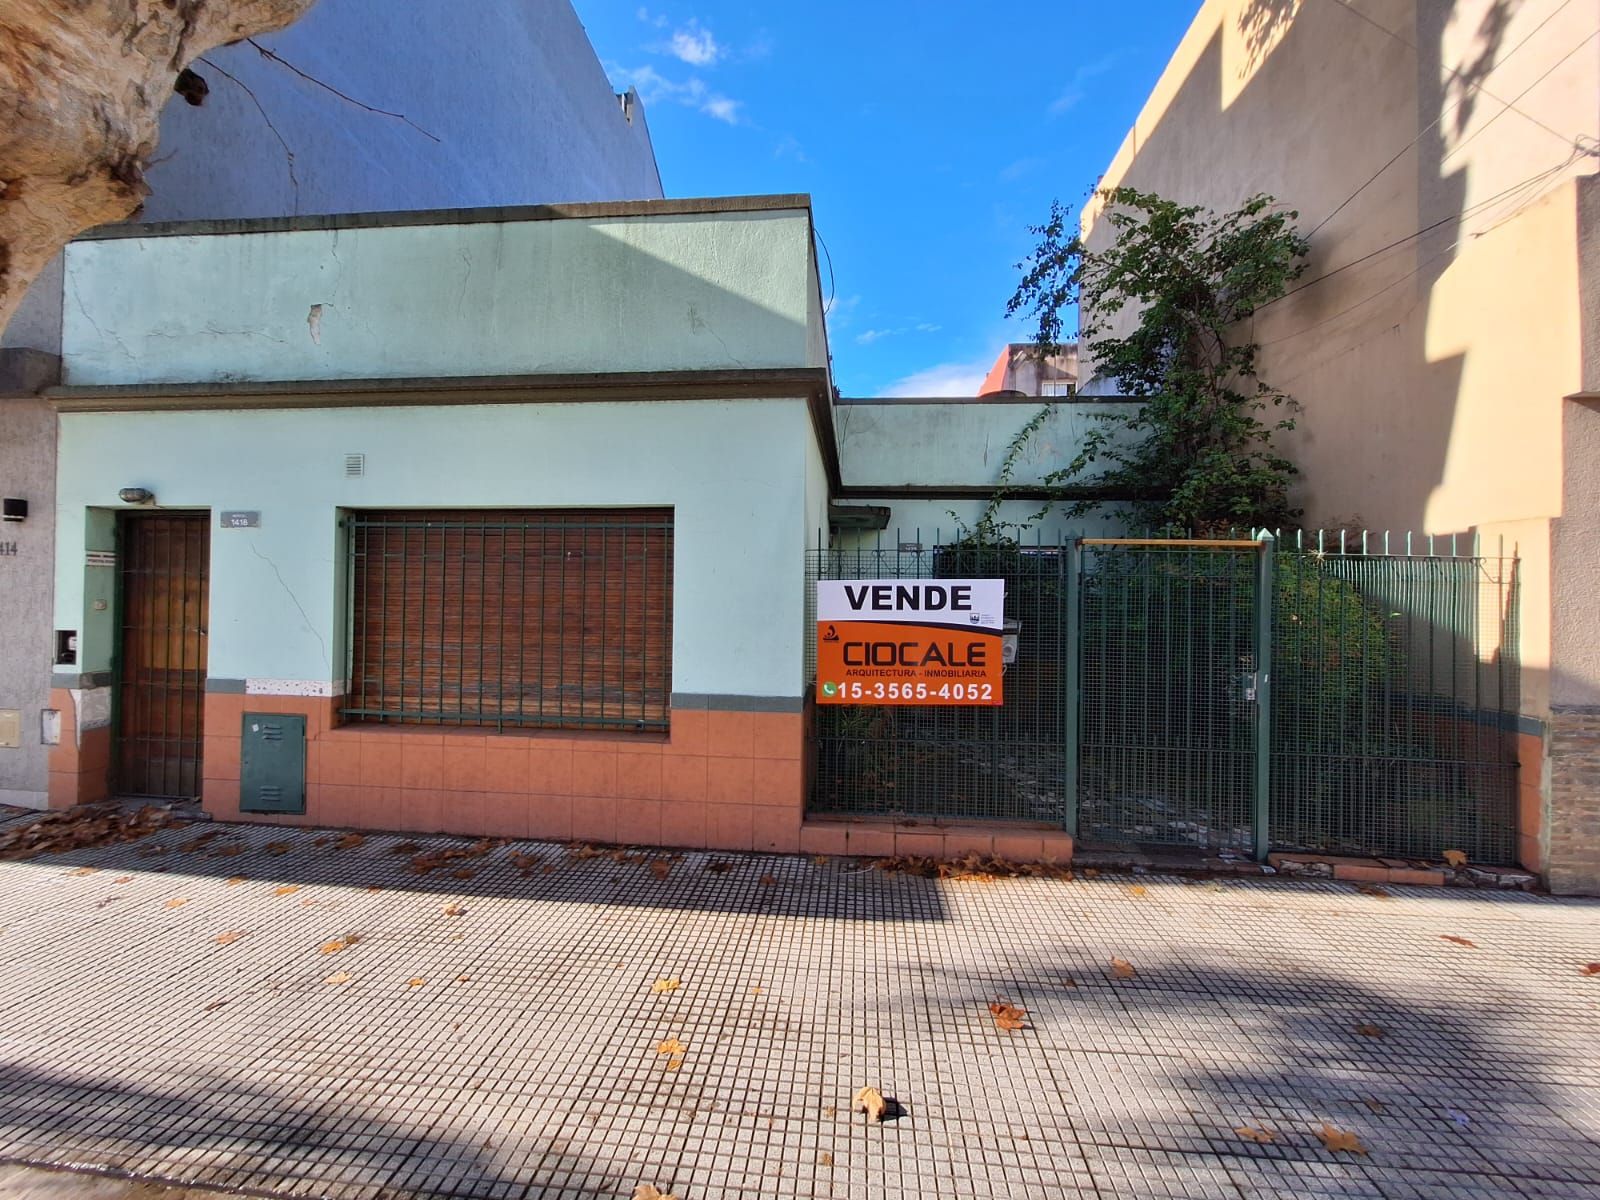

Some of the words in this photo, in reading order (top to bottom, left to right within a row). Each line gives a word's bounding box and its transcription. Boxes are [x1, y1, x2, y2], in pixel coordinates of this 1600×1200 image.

[844, 585, 972, 611] VENDE
[843, 642, 986, 667] CIOCALE
[846, 669, 917, 678] ARQUITECTURA
[924, 669, 987, 678] INMOBILIARIA
[837, 682, 992, 700] 15-3565-4052
